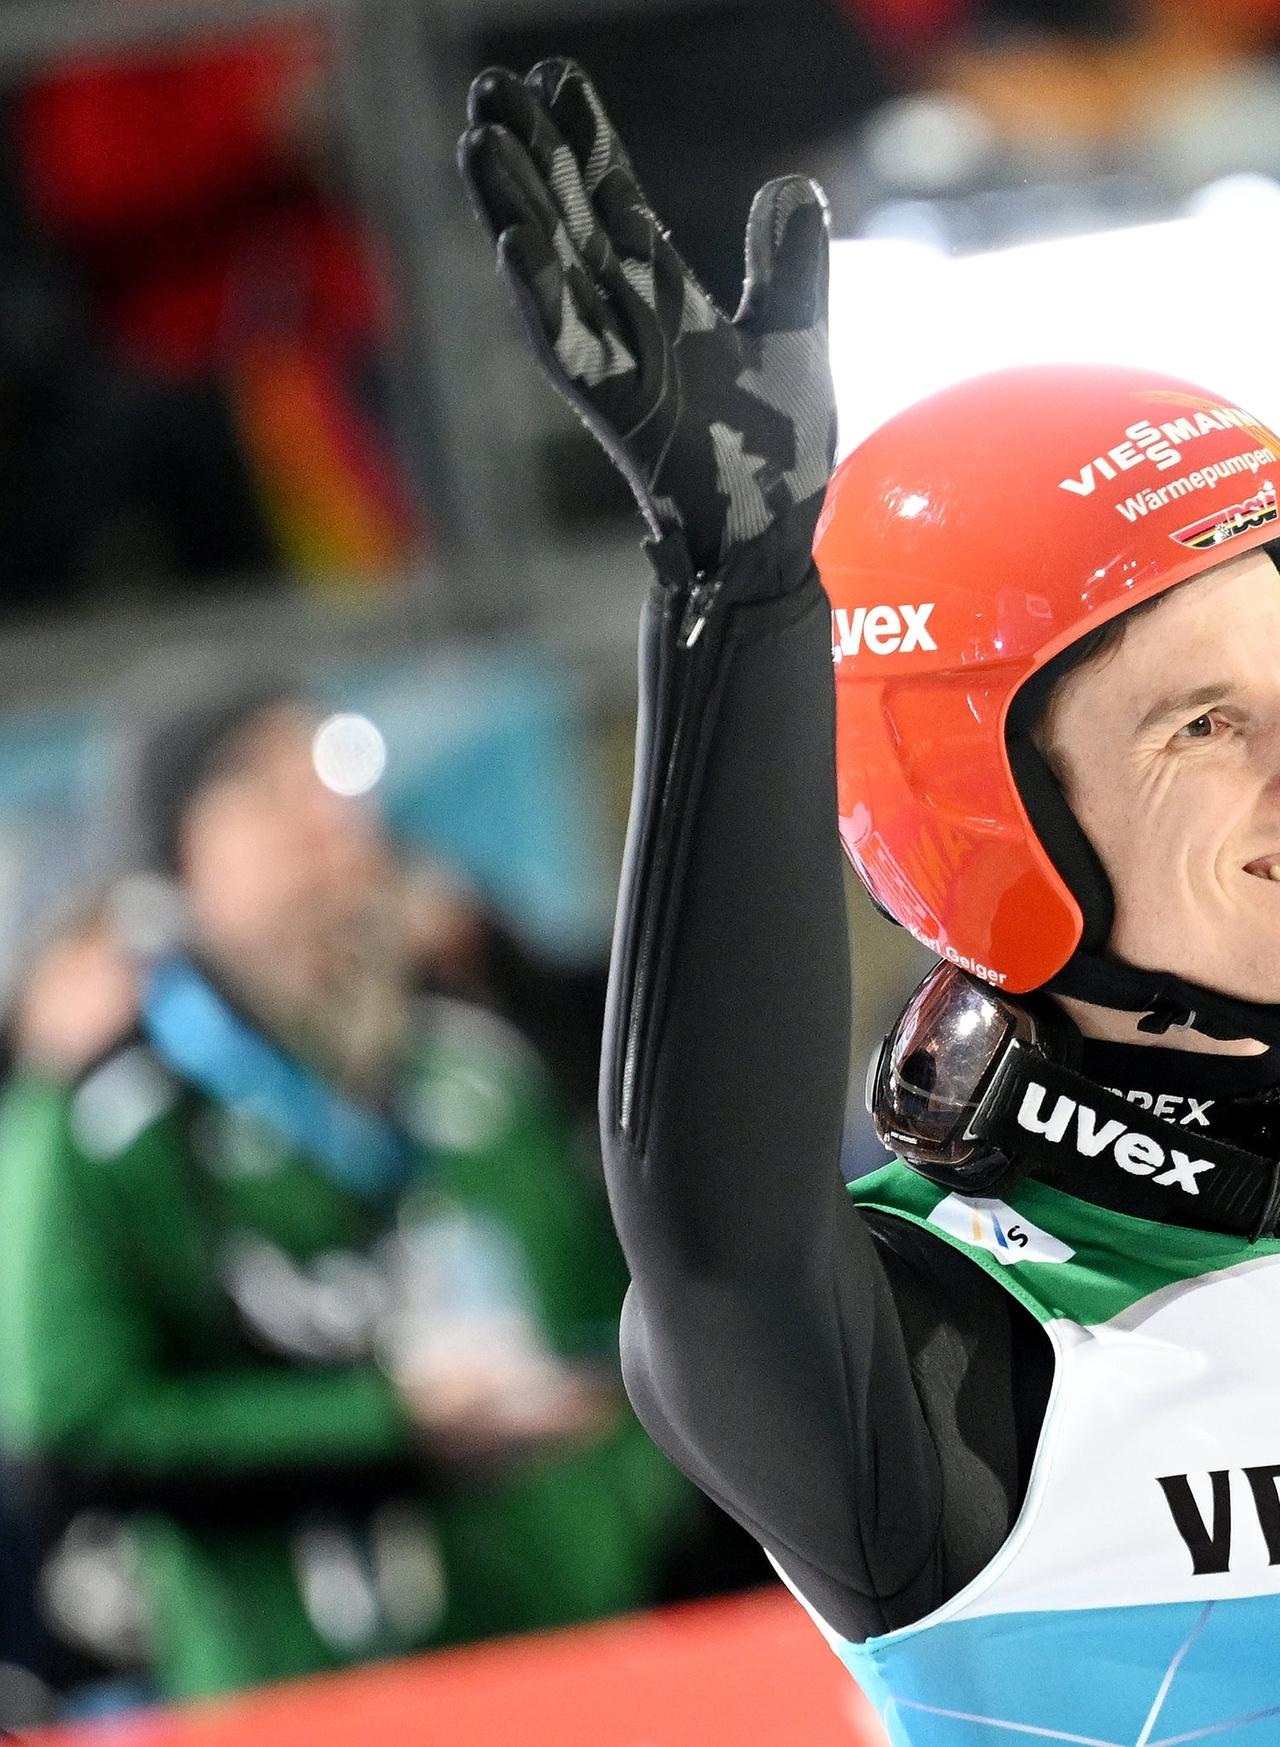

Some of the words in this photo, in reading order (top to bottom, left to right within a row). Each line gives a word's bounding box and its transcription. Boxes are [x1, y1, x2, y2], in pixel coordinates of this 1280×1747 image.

[1115, 446, 1277, 523] Wärmepumpen
[831, 603, 938, 662] vex
[944, 945, 1008, 985] Geiger
[1017, 1081, 1216, 1196] uvex
